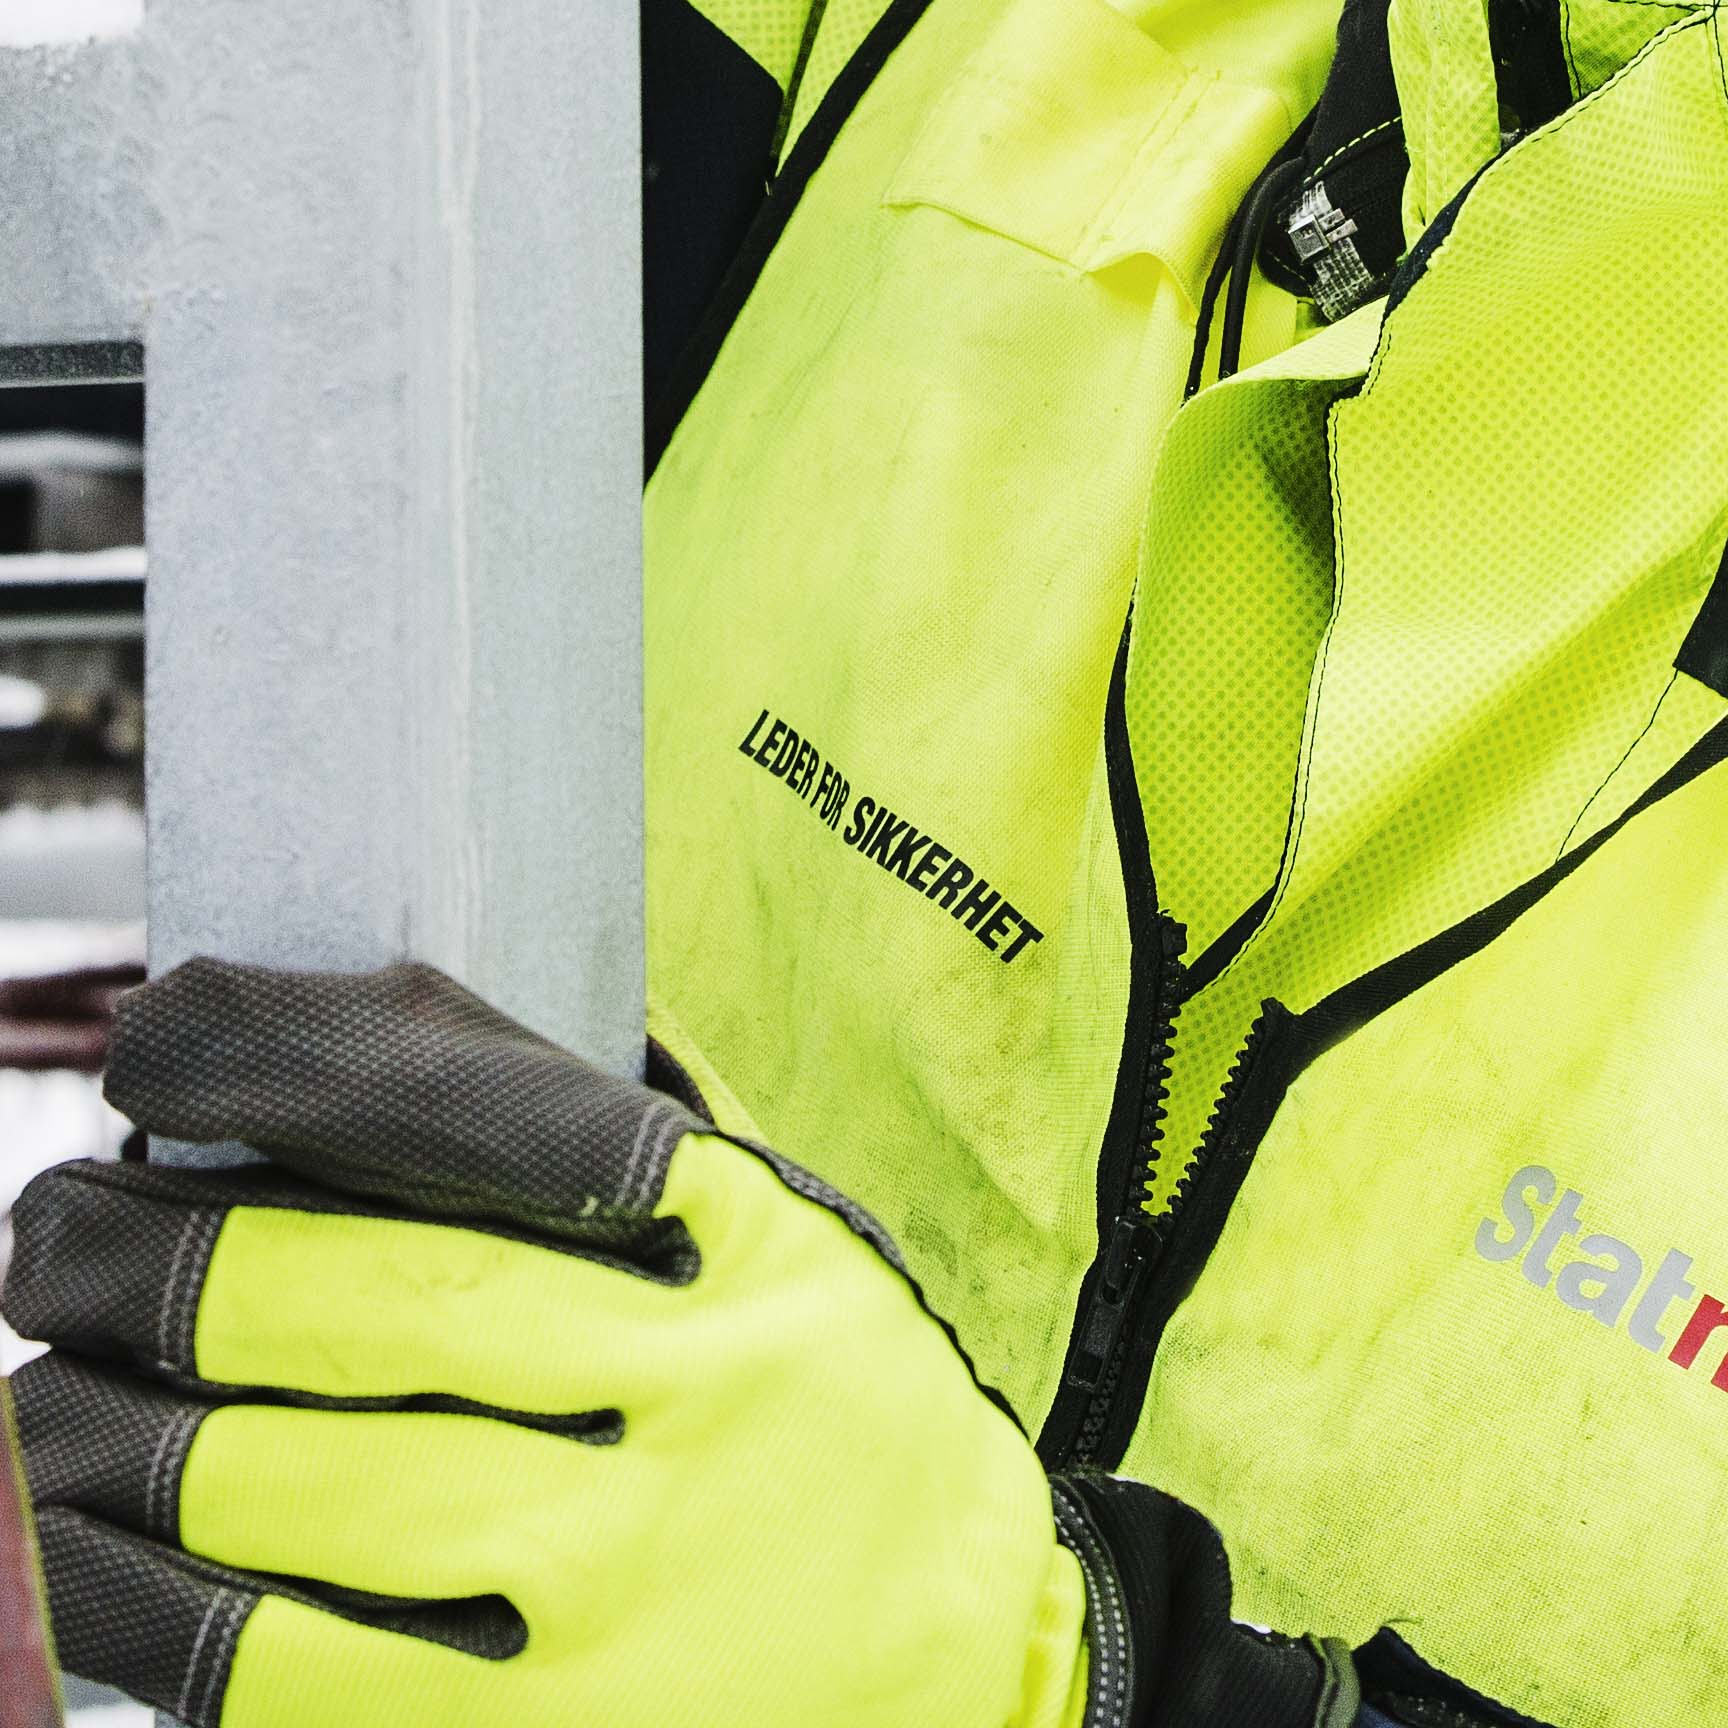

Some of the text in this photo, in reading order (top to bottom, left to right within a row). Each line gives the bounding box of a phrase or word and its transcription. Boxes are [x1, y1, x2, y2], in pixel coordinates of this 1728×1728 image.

[738, 709, 1044, 963] LEDER FOR SIKKERHET
